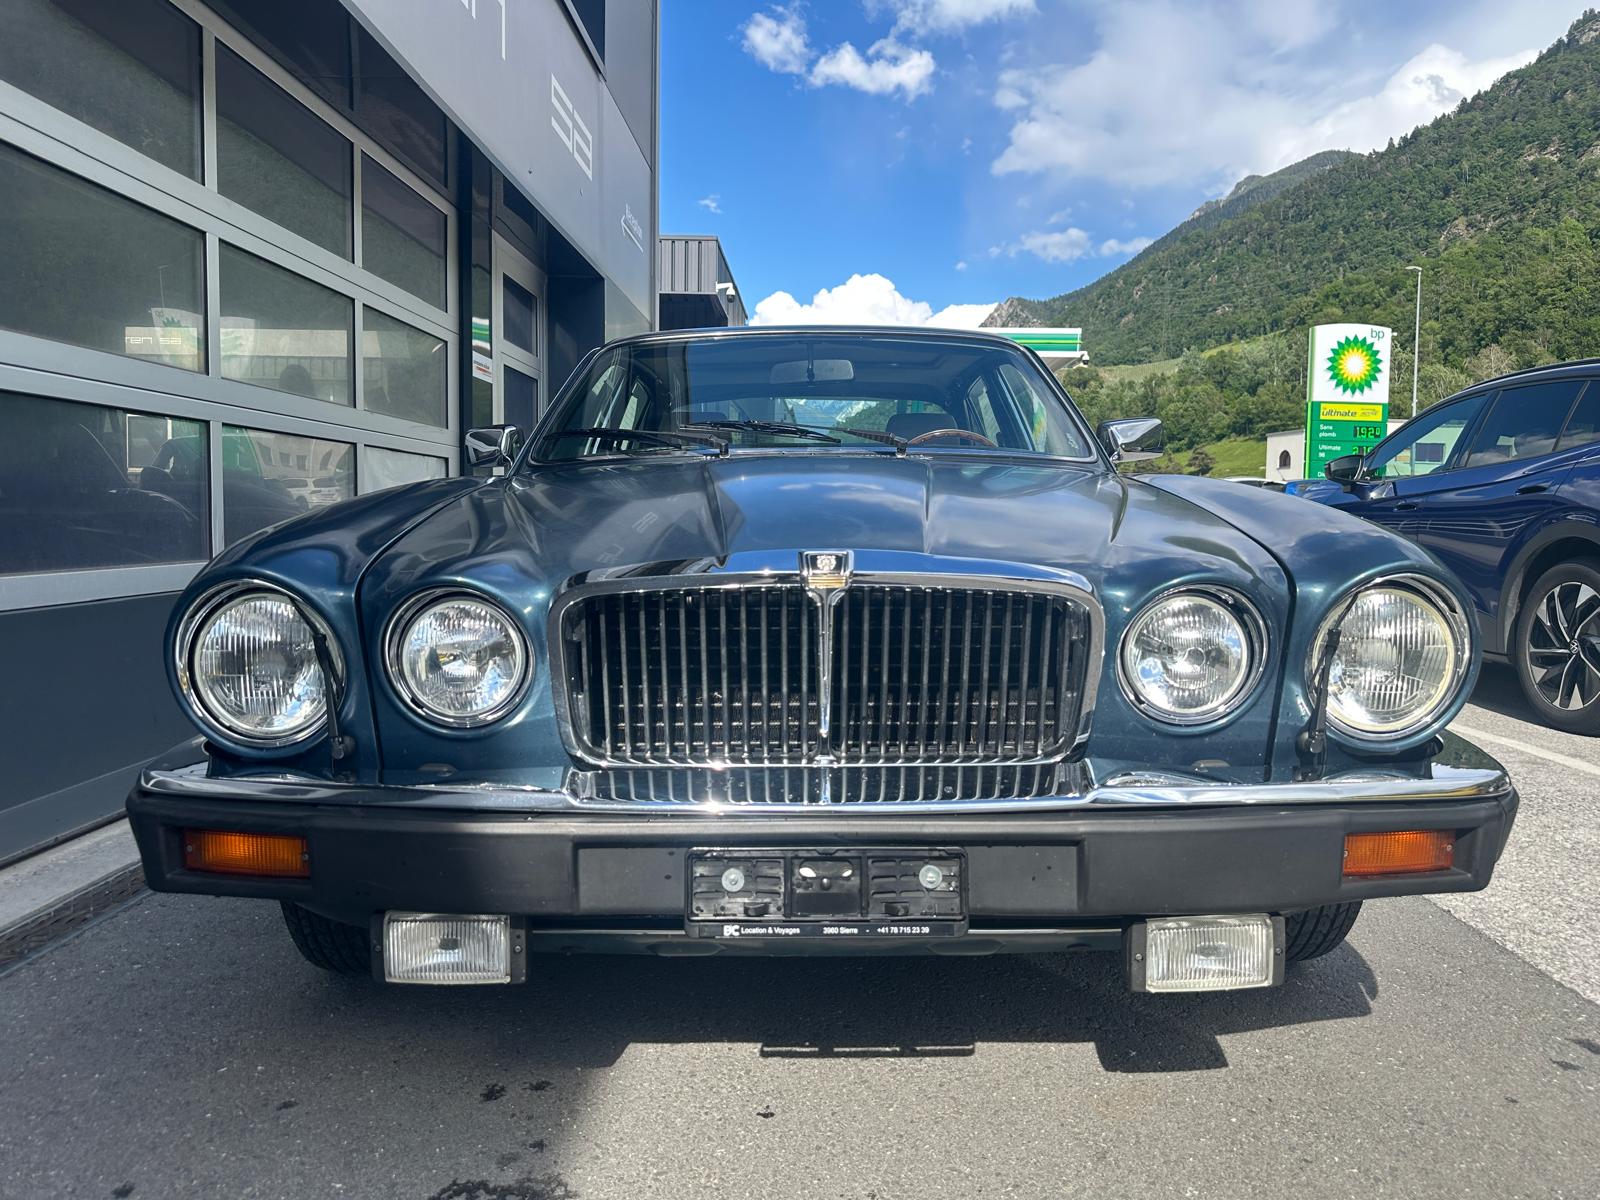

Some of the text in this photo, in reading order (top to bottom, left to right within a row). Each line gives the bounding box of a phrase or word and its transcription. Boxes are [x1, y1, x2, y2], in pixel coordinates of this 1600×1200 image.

[1370, 328, 1385, 341] bp
[774, 927, 800, 935] Voyages
[840, 926, 858, 934] Sierre
[877, 926, 889, 934] +41
[899, 926, 911, 934] 715
[912, 926, 920, 934] 23
